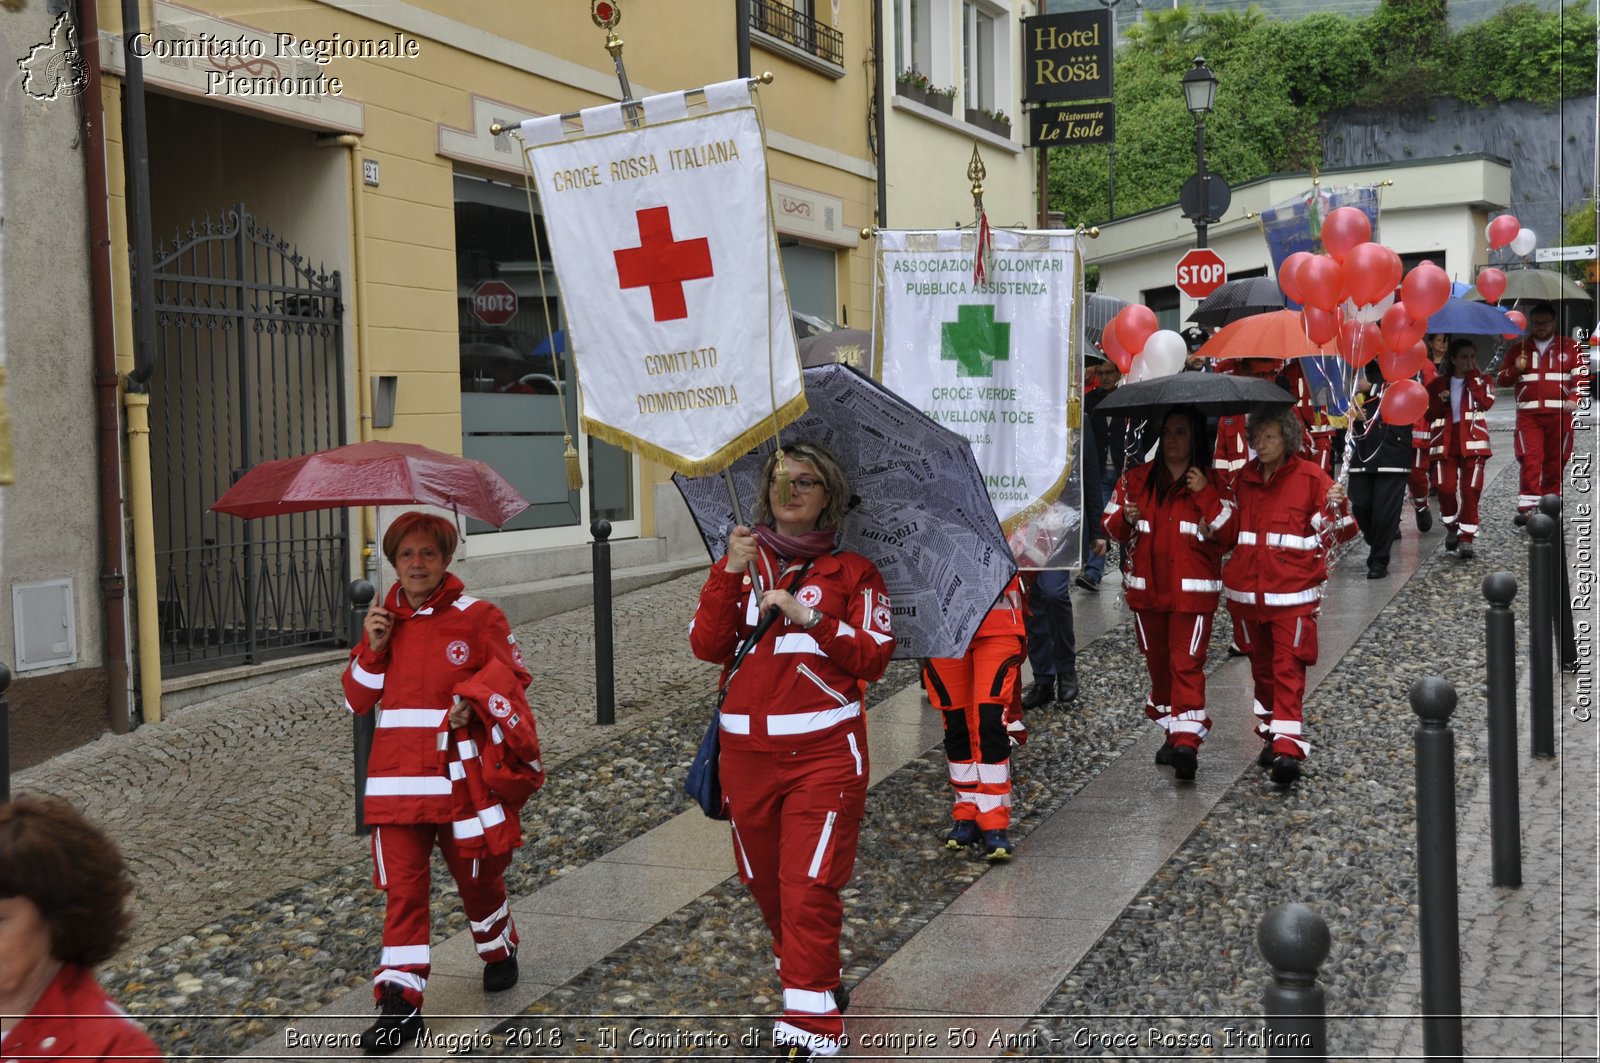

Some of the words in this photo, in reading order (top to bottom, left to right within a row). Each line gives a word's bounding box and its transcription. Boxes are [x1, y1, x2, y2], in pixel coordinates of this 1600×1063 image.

[1034, 23, 1100, 51] Hotel
[1034, 59, 1100, 85] Rosa
[1058, 111, 1104, 122] Ristorante
[1039, 123, 1060, 141] Le
[1065, 121, 1104, 138] Isole
[365, 164, 378, 180] 21
[553, 165, 602, 192] CROCE
[610, 154, 659, 182] ROSSA
[669, 139, 739, 171] ITALIANA
[893, 259, 976, 272] ASSOCIAZION
[1179, 264, 1223, 284] STOP
[906, 282, 967, 295] PUBBLICA
[972, 282, 1048, 295] ASSISTENZA
[645, 347, 717, 375] COMITATO
[637, 384, 738, 414] DOMODOSSOLA
[932, 387, 973, 400] CROCE
[978, 387, 1017, 401] VERDE
[1001, 411, 1034, 424] TOCE
[984, 475, 1027, 488] INCIA
[999, 491, 1029, 501] OSSOLA
